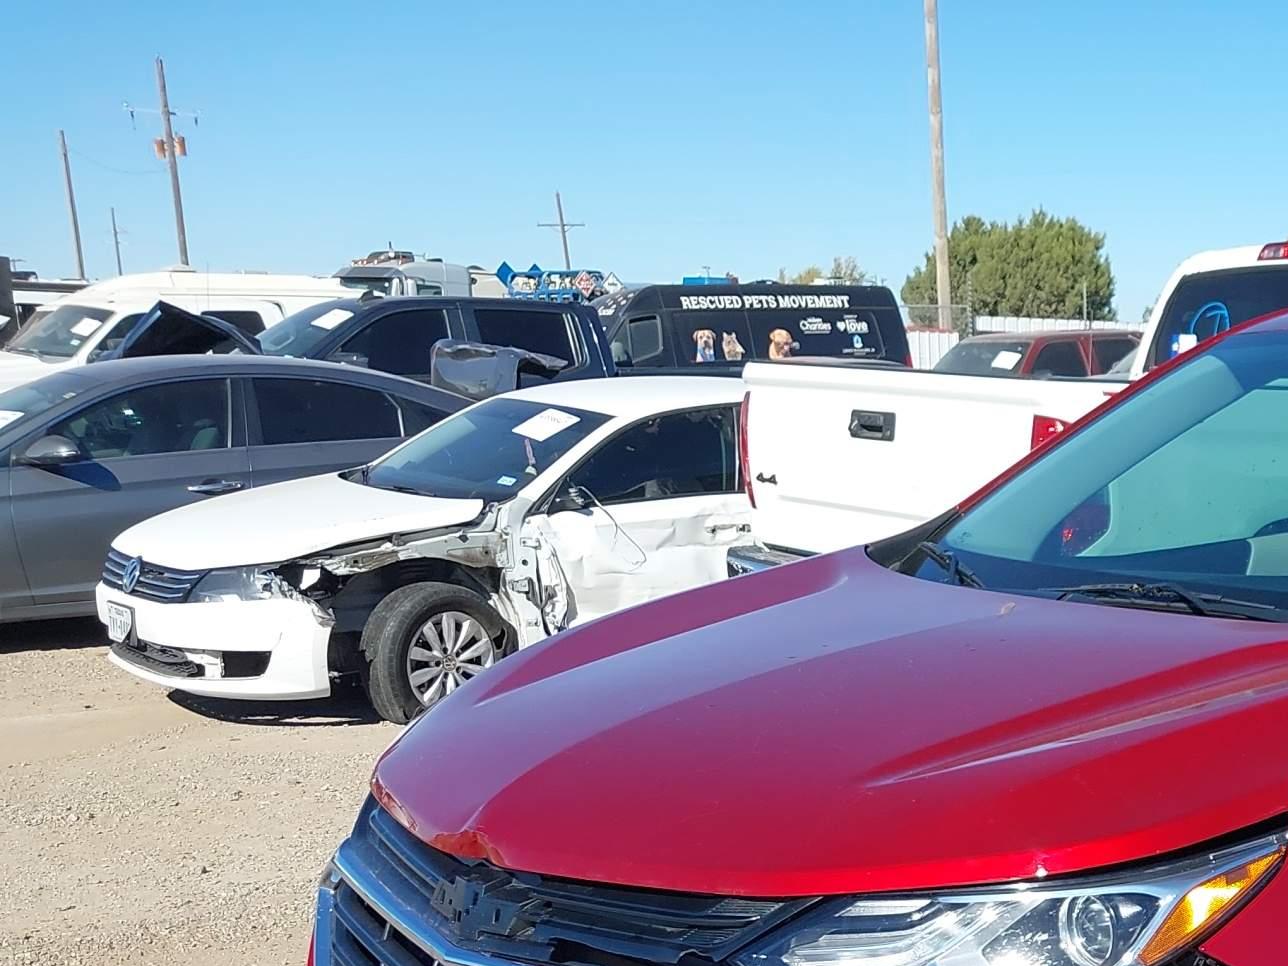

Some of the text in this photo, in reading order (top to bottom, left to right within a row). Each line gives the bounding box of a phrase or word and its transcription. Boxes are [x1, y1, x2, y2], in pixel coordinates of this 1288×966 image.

[680, 295, 850, 310] RESCUED PETS MOVEMENT
